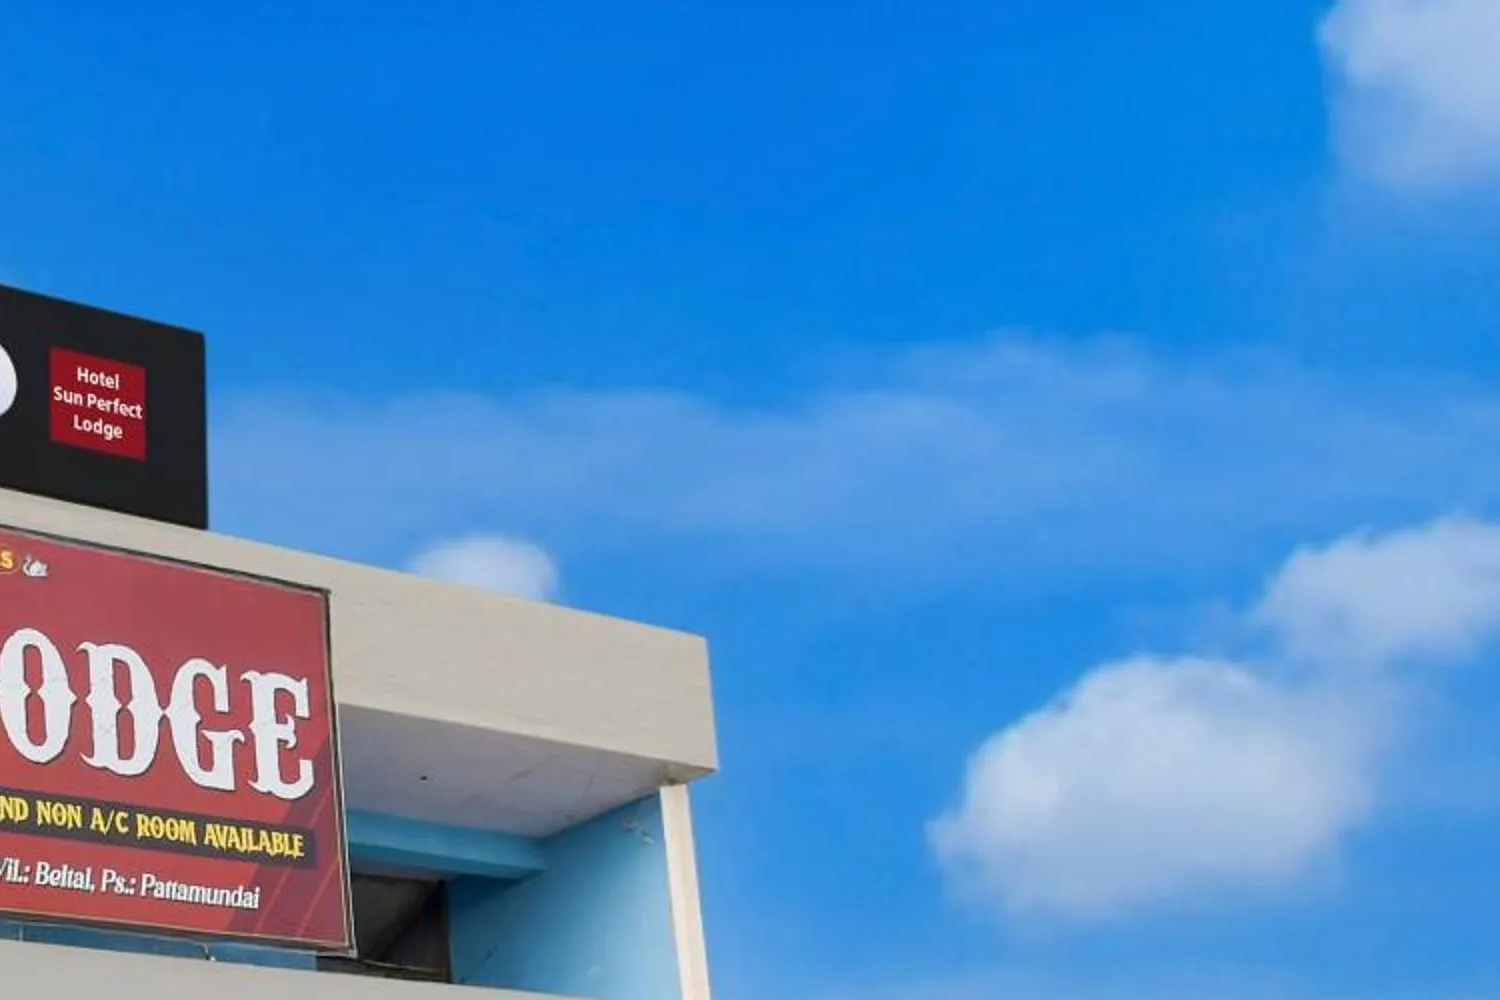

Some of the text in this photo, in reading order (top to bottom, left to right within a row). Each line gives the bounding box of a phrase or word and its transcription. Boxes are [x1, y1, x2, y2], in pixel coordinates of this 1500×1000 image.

[76, 366, 120, 391] Hotel
[53, 385, 143, 420] Sun Perfect
[73, 413, 123, 441] Lodge
[36, 799, 83, 830] NON
[89, 806, 129, 836] A/C
[135, 812, 197, 847] ROOM
[203, 822, 306, 860] AVAILABLE
[100, 867, 136, 896] Ps.:
[140, 872, 261, 909] Pattamundai
